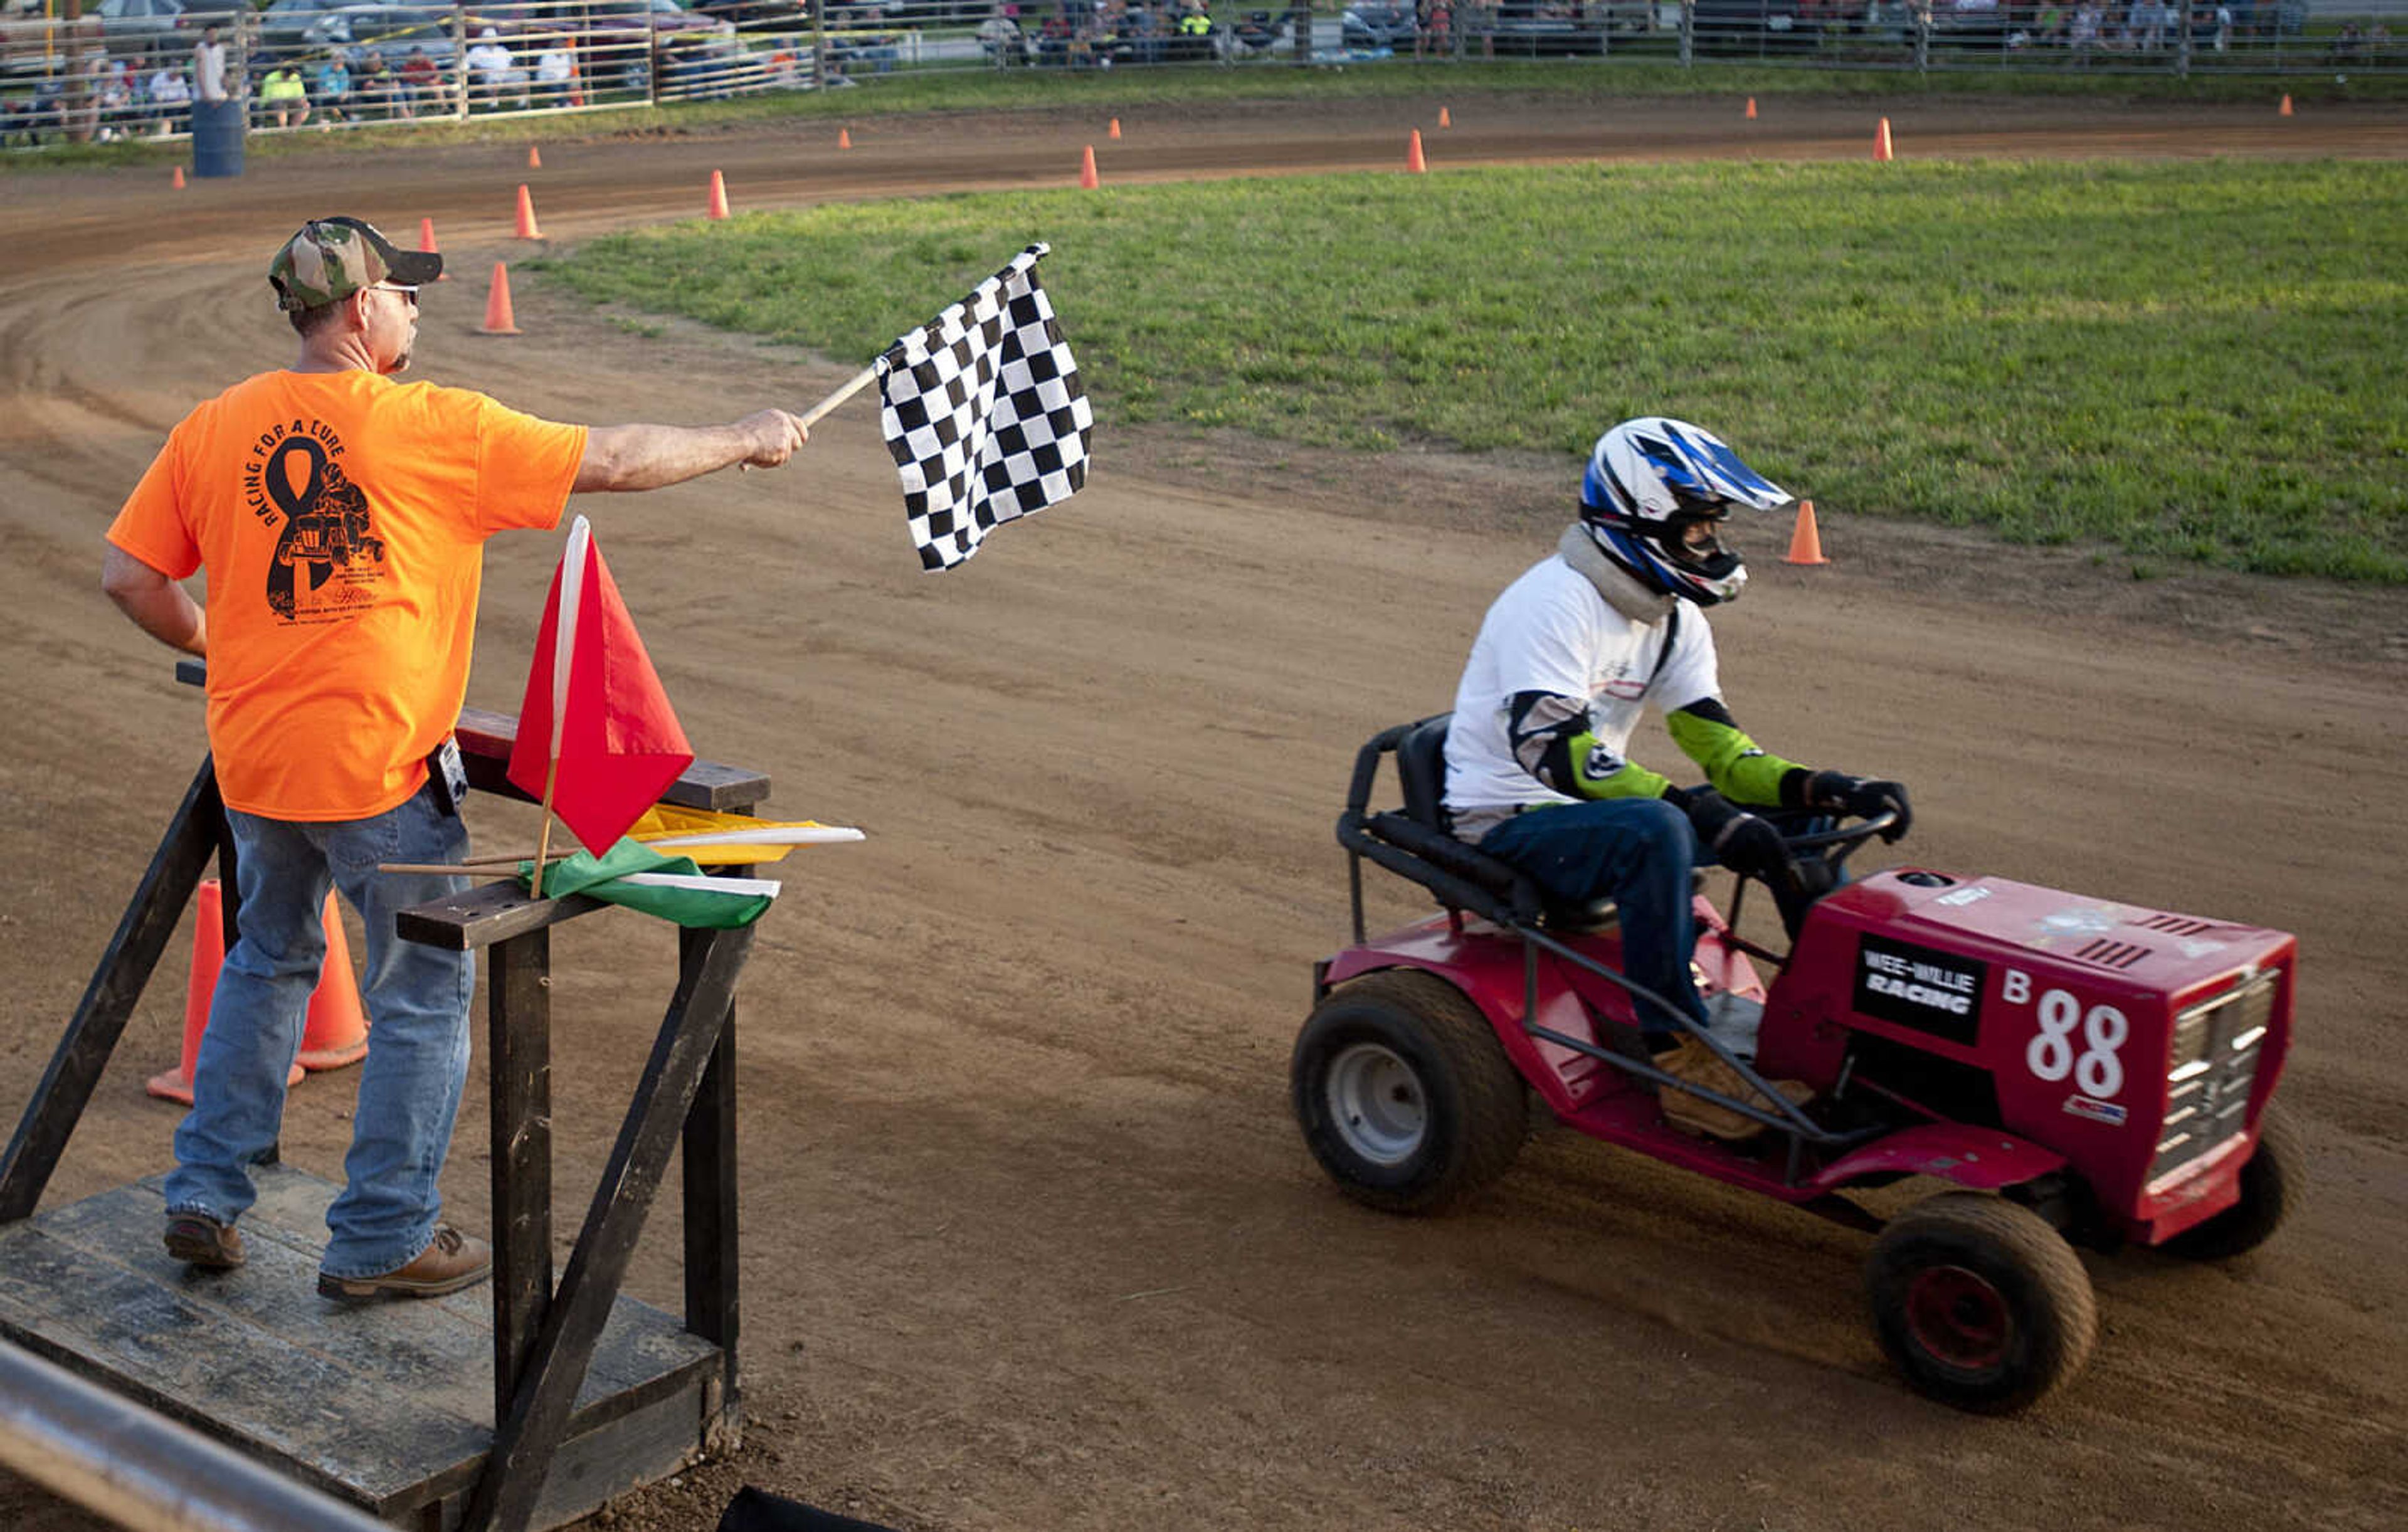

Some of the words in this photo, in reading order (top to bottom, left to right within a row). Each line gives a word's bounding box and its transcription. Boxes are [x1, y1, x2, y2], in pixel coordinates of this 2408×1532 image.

[253, 424, 286, 457] FOR
[291, 419, 304, 433] A
[311, 419, 345, 457] CURE
[244, 462, 278, 527] RACING
[1864, 949, 1975, 993] WEE-WILLIE
[1866, 972, 1972, 1015] RACING
[2002, 968, 2032, 1004] B
[2025, 988, 2129, 1099] 88
